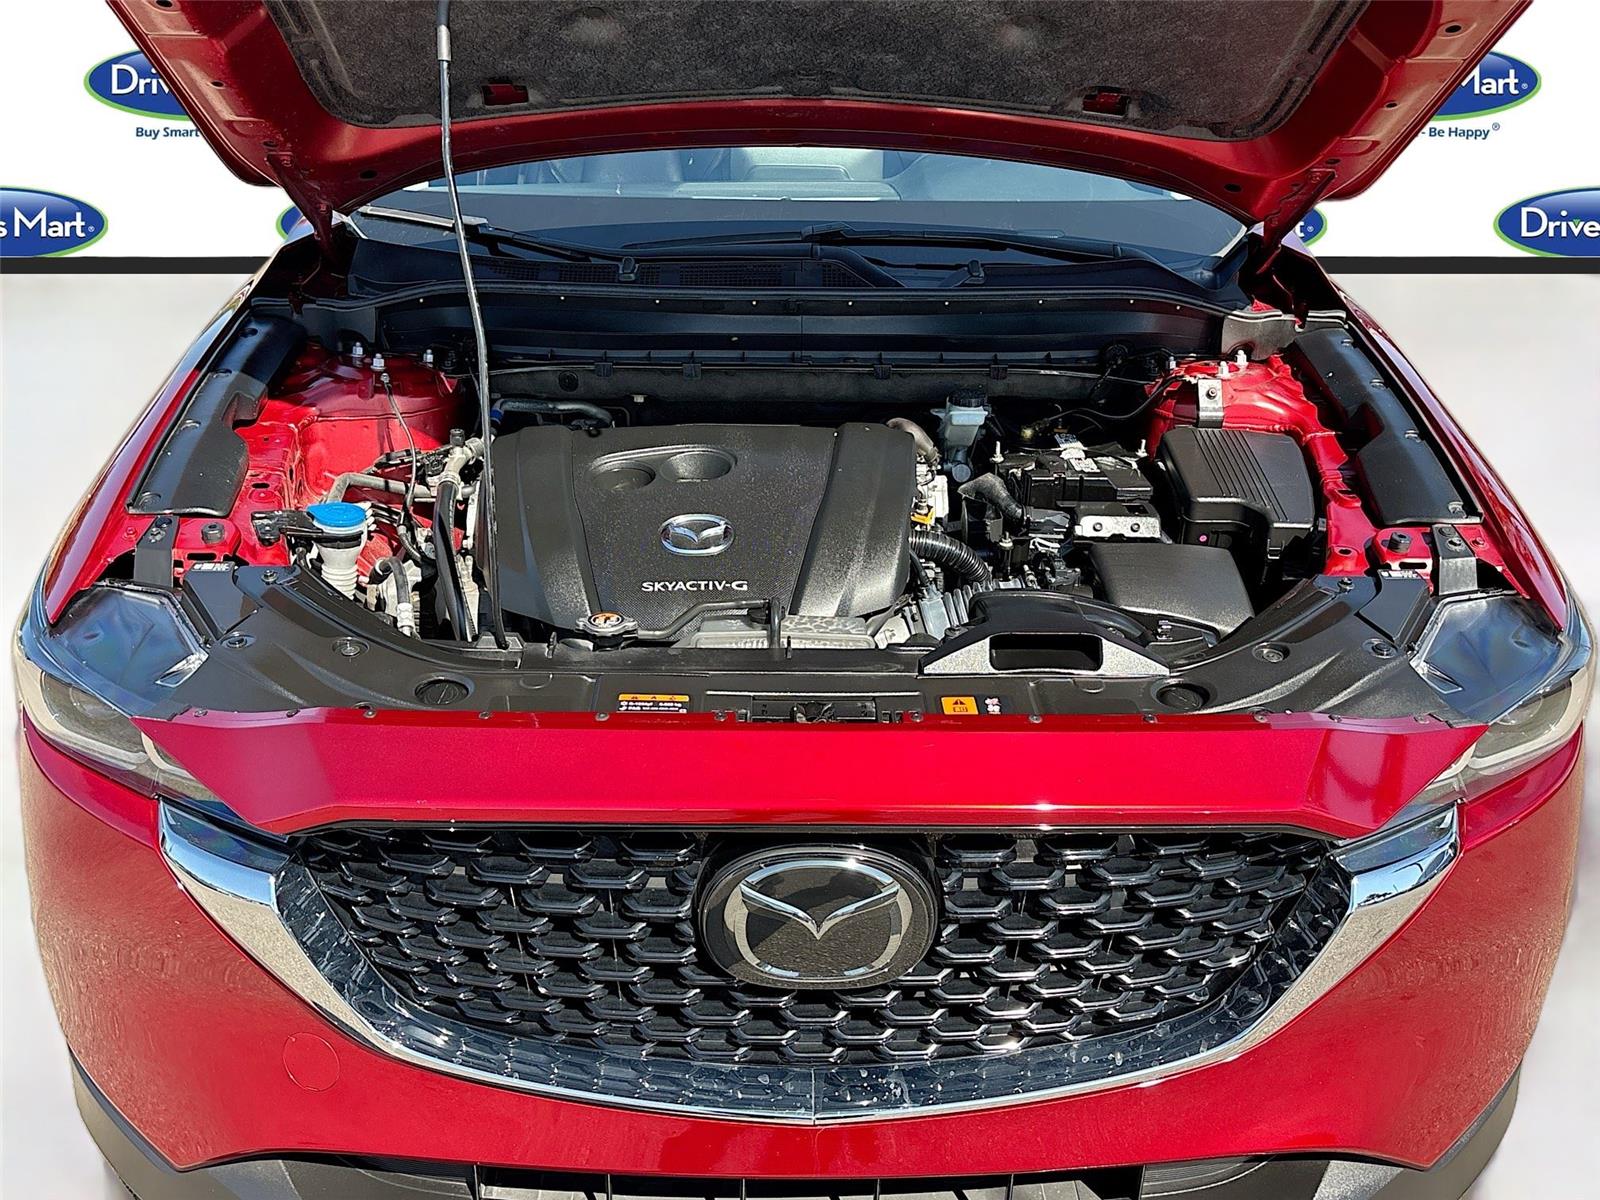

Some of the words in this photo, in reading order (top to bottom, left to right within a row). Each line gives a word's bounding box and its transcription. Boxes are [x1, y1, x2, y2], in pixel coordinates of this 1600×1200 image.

[136, 127, 160, 140] Buy
[163, 127, 200, 137] Smart
[1429, 127, 1445, 137] Be
[1448, 127, 1490, 140] Happy
[14, 207, 86, 238] Mart
[1521, 207, 1600, 238] Drive
[641, 580, 749, 592] SKYACTIV-G
